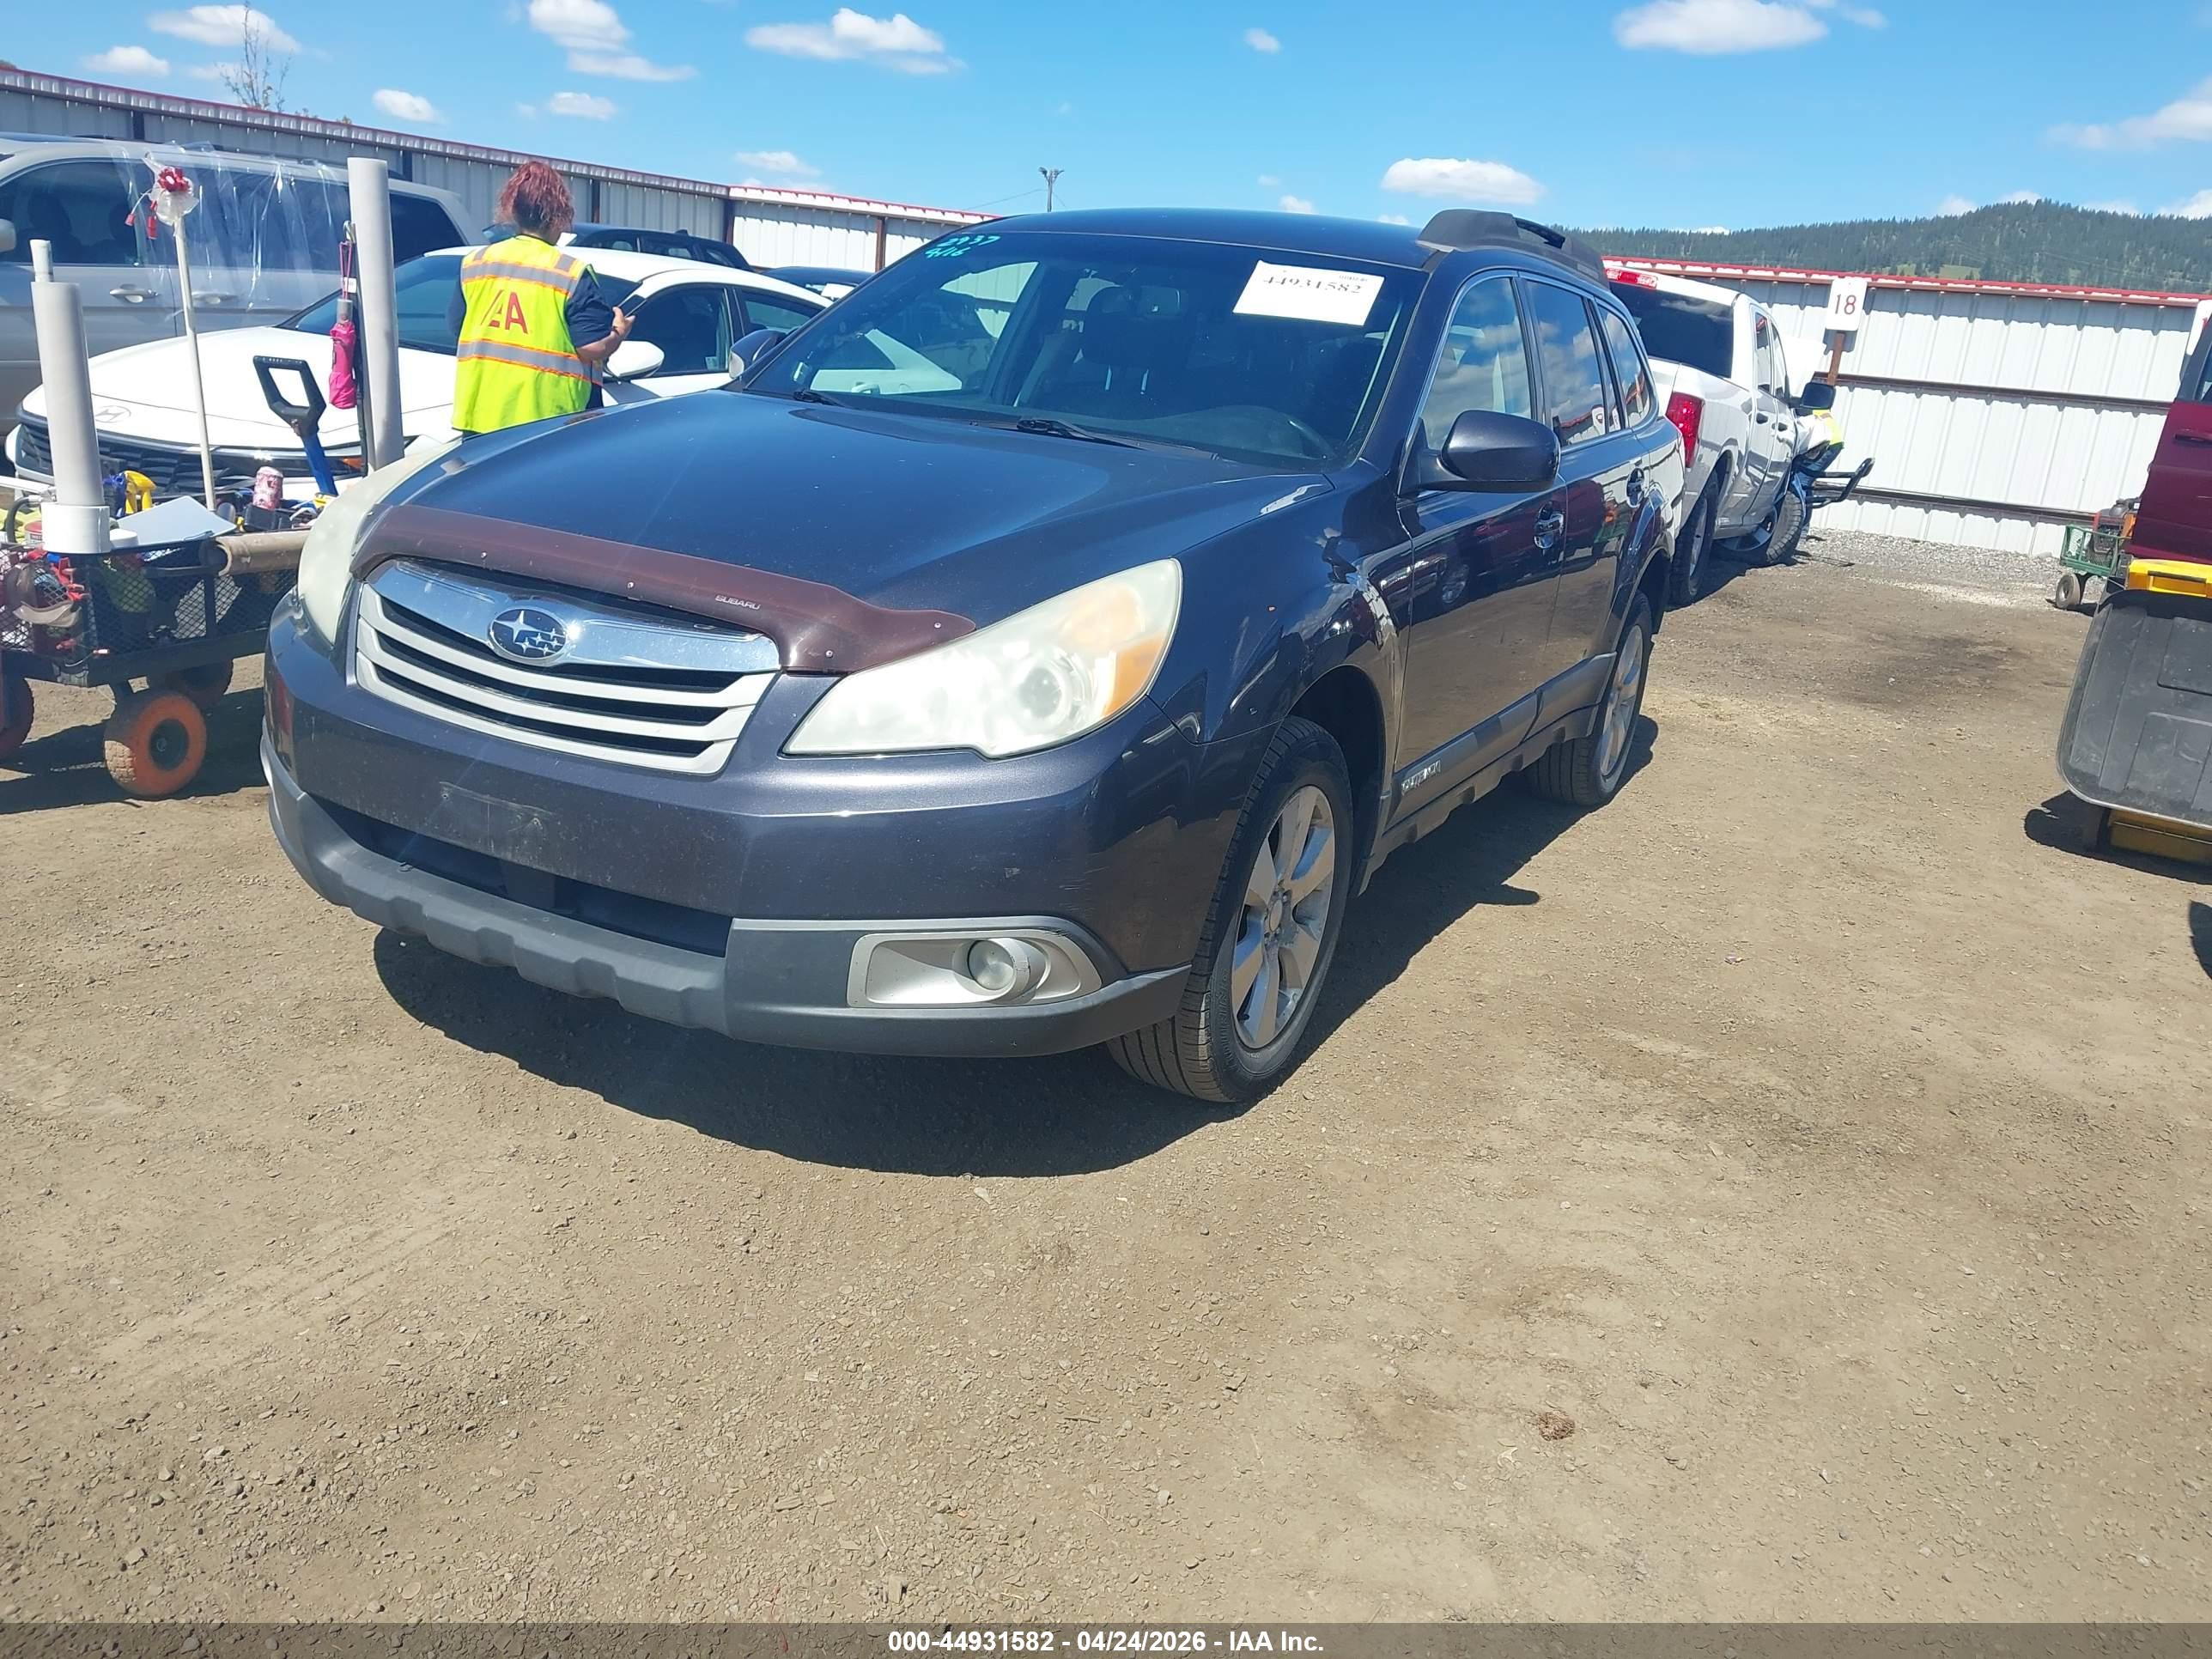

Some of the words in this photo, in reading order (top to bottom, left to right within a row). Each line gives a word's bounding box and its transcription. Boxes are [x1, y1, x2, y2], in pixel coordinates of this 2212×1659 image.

[1262, 276, 1363, 295] 44931582
[480, 289, 529, 335] IAA
[1835, 294, 1856, 315] 18
[714, 594, 762, 611] SUBARU
